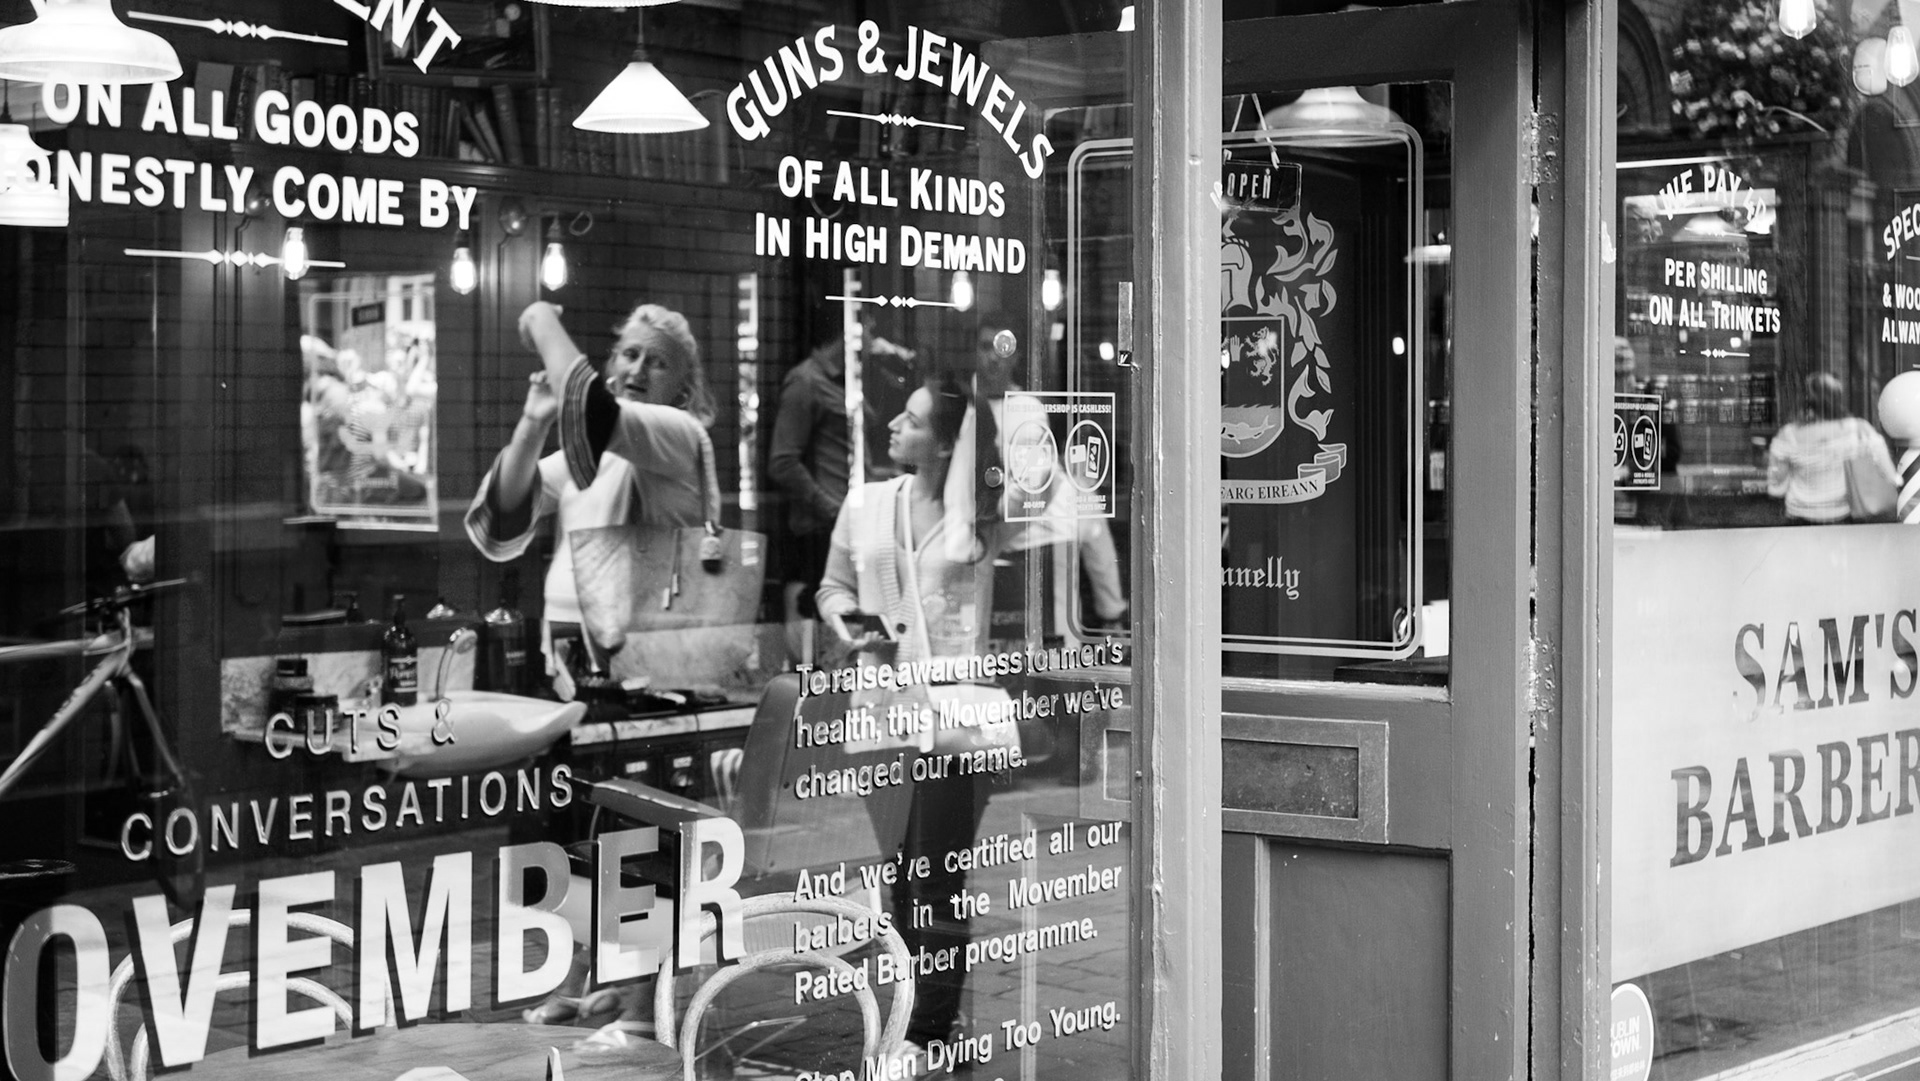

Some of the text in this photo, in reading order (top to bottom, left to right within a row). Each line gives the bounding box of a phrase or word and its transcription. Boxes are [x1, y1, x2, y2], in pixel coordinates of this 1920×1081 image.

[333, 0, 462, 74] NT
[42, 72, 420, 158] ON ALL GOODS
[726, 20, 1055, 180] GUNS & JEWELS
[272, 165, 404, 226] COME
[419, 177, 477, 230] BY
[778, 155, 1006, 218] OF ALL KINDS
[1227, 172, 1271, 199] OPEN
[1659, 169, 1694, 221] WE
[1703, 165, 1742, 208] PAY
[755, 212, 1027, 274] IN HIGH DEMAND
[1664, 257, 1768, 295] PER SHILLING
[1882, 282, 1892, 309] &
[1649, 295, 1781, 333] ON ALL TRINKETS
[1079, 403, 1112, 414] CASHLESS!
[1258, 479, 1319, 499] EIREANN
[796, 635, 1123, 697] To raise awareness for men's
[1732, 608, 1919, 723] SAM'S
[263, 698, 459, 760] CUTS &
[796, 682, 1124, 748] health, this Movember we've
[795, 744, 1028, 799] changed our name.
[120, 763, 576, 862] CONVERSATIONS
[794, 862, 846, 901] And
[944, 829, 1037, 874] certified
[1049, 822, 1074, 855] all
[1087, 820, 1122, 848] our
[794, 865, 1122, 954] barbers in the Movember
[794, 917, 1098, 1004] Rated Barber programme.
[864, 1001, 1121, 1081] Men Dying Too Young.
